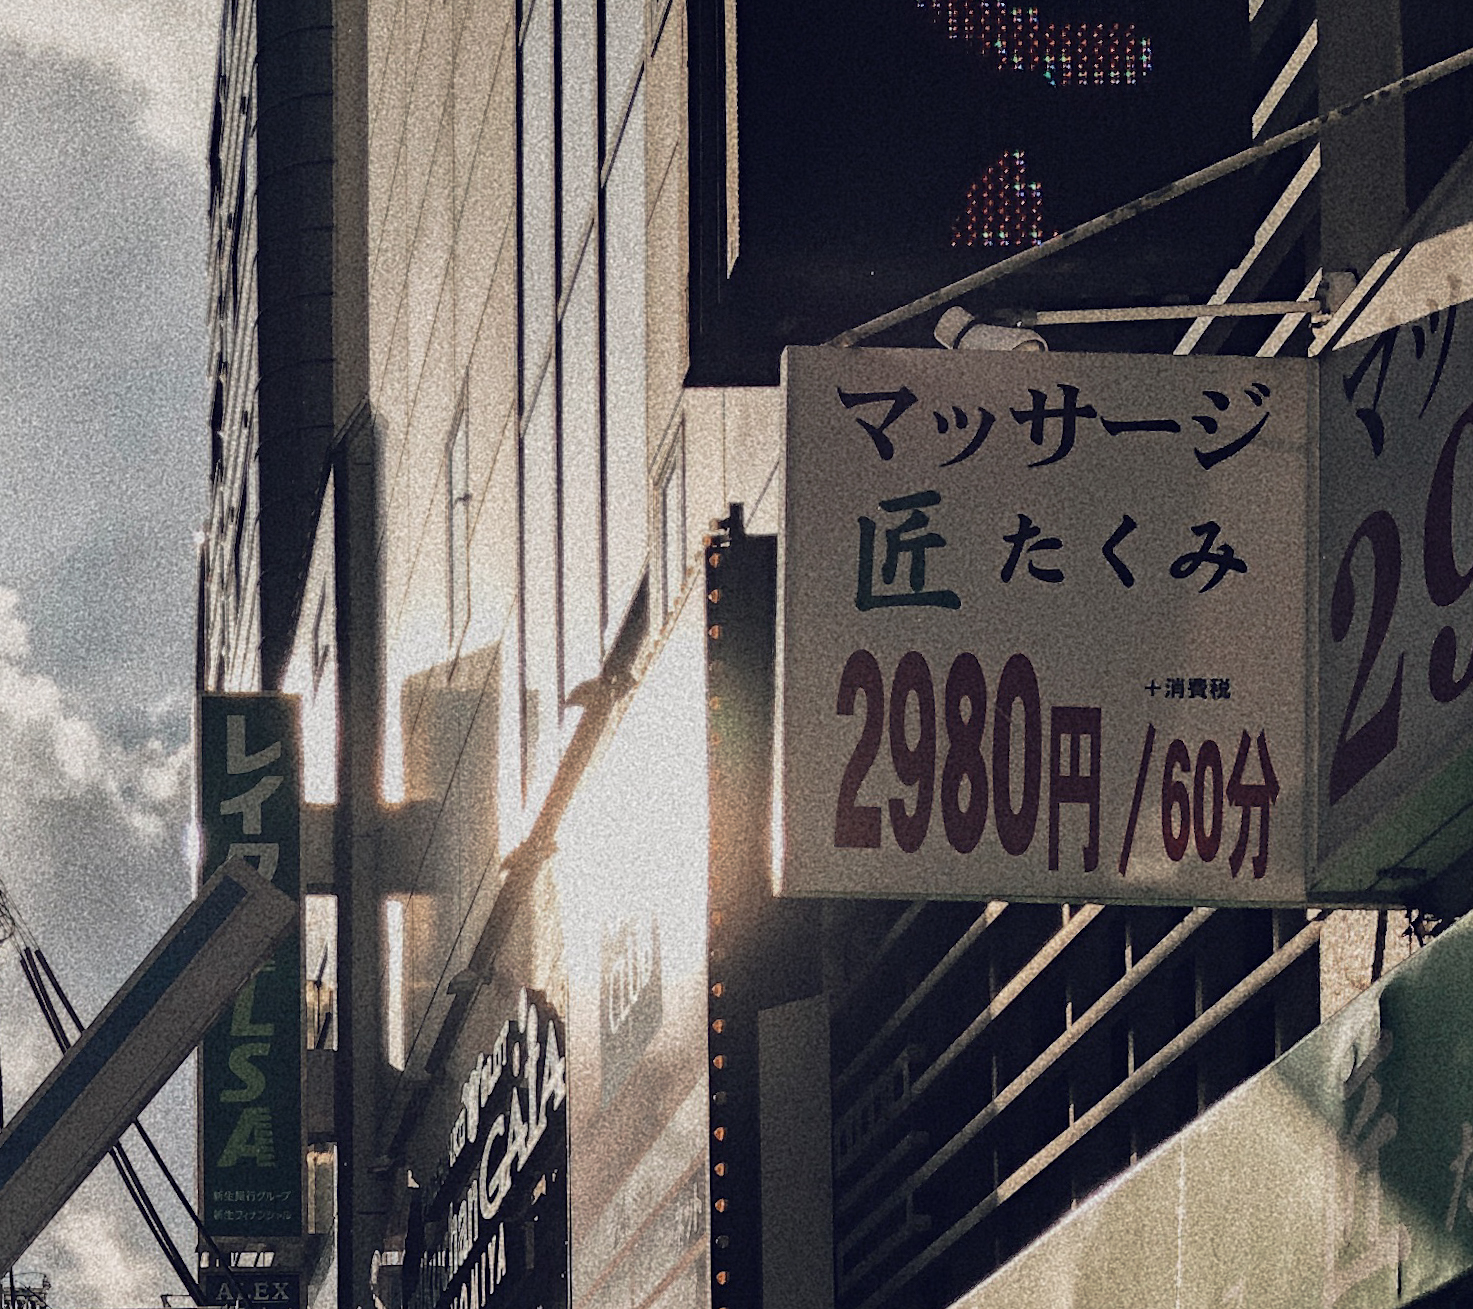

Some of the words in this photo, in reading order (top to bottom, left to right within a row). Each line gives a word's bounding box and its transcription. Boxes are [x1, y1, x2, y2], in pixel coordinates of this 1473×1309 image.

[835, 382, 1272, 471] マッサージ
[854, 489, 963, 612] 匠
[999, 513, 1248, 594] たくみ
[216, 957, 278, 1168] LSA
